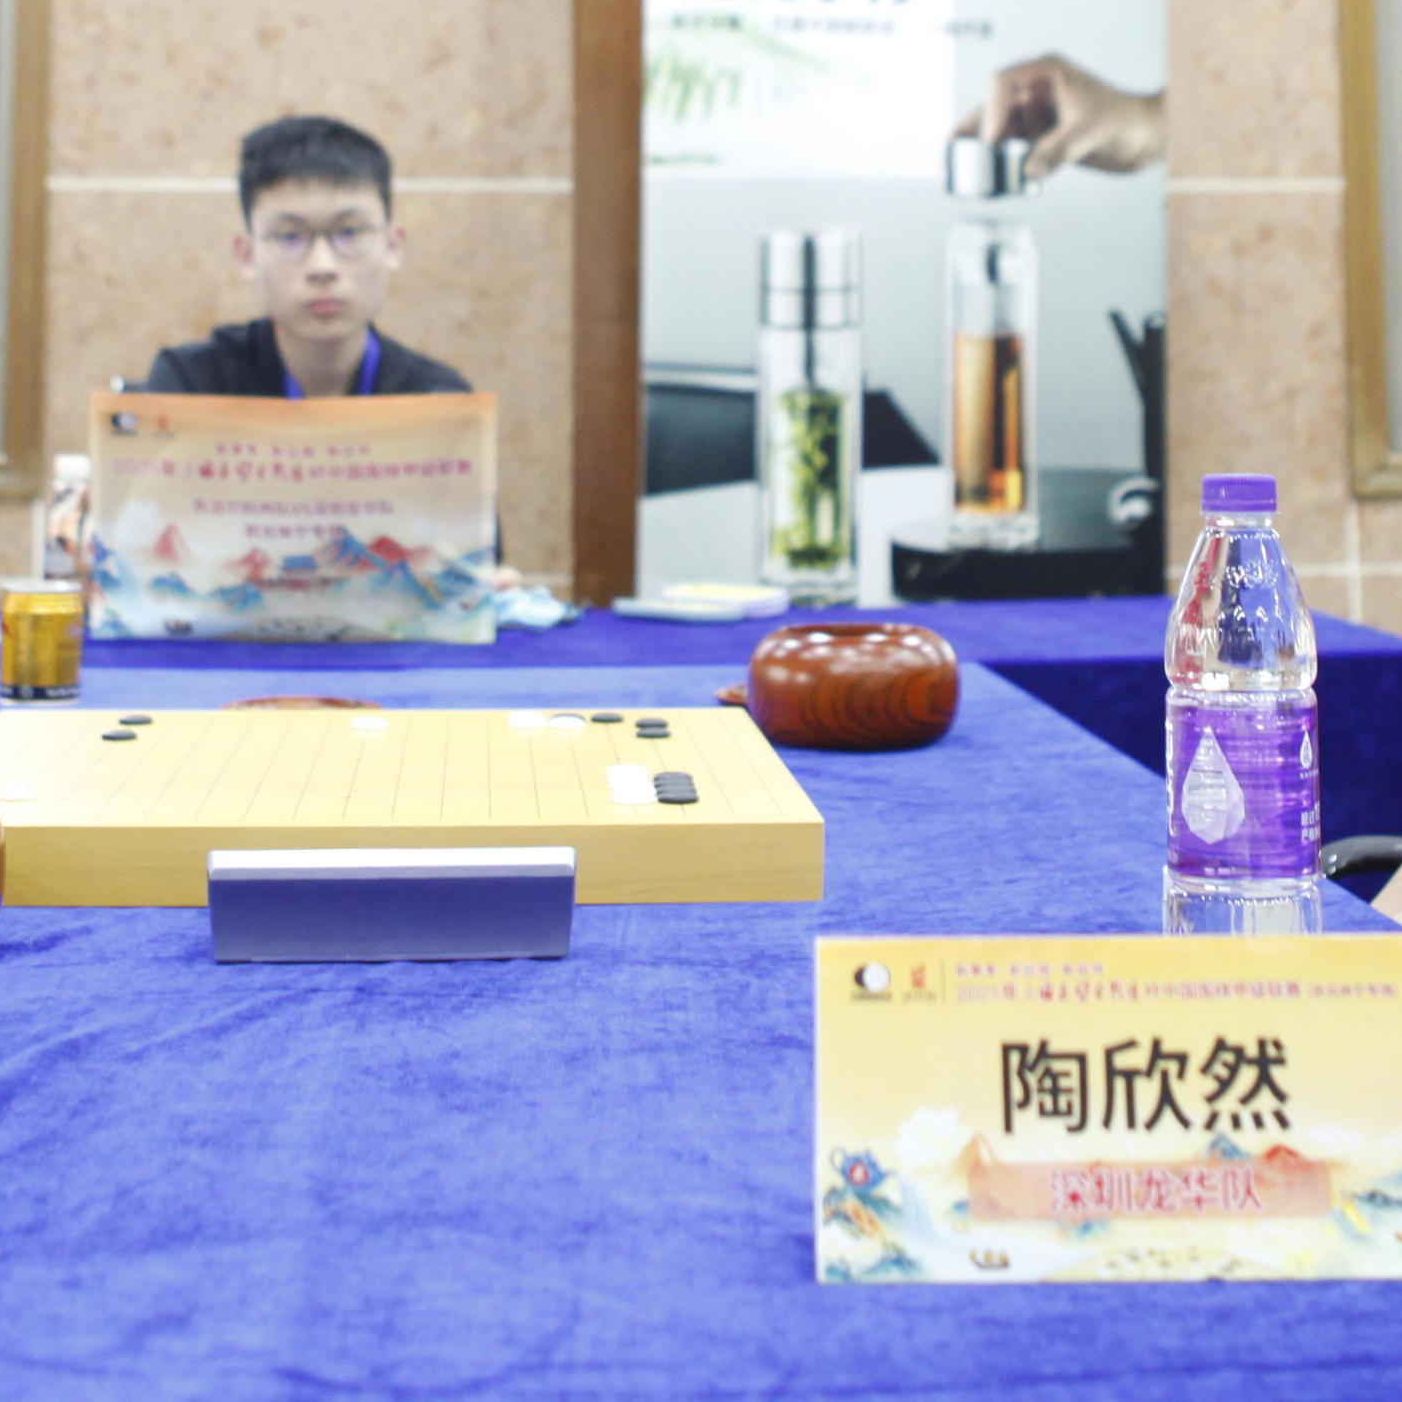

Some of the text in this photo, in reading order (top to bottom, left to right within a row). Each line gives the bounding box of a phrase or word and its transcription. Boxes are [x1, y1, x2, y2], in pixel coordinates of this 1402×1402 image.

[1000, 1036, 1291, 1134] 陶欣然
[1051, 1169, 1263, 1211] 深圳龙华队
